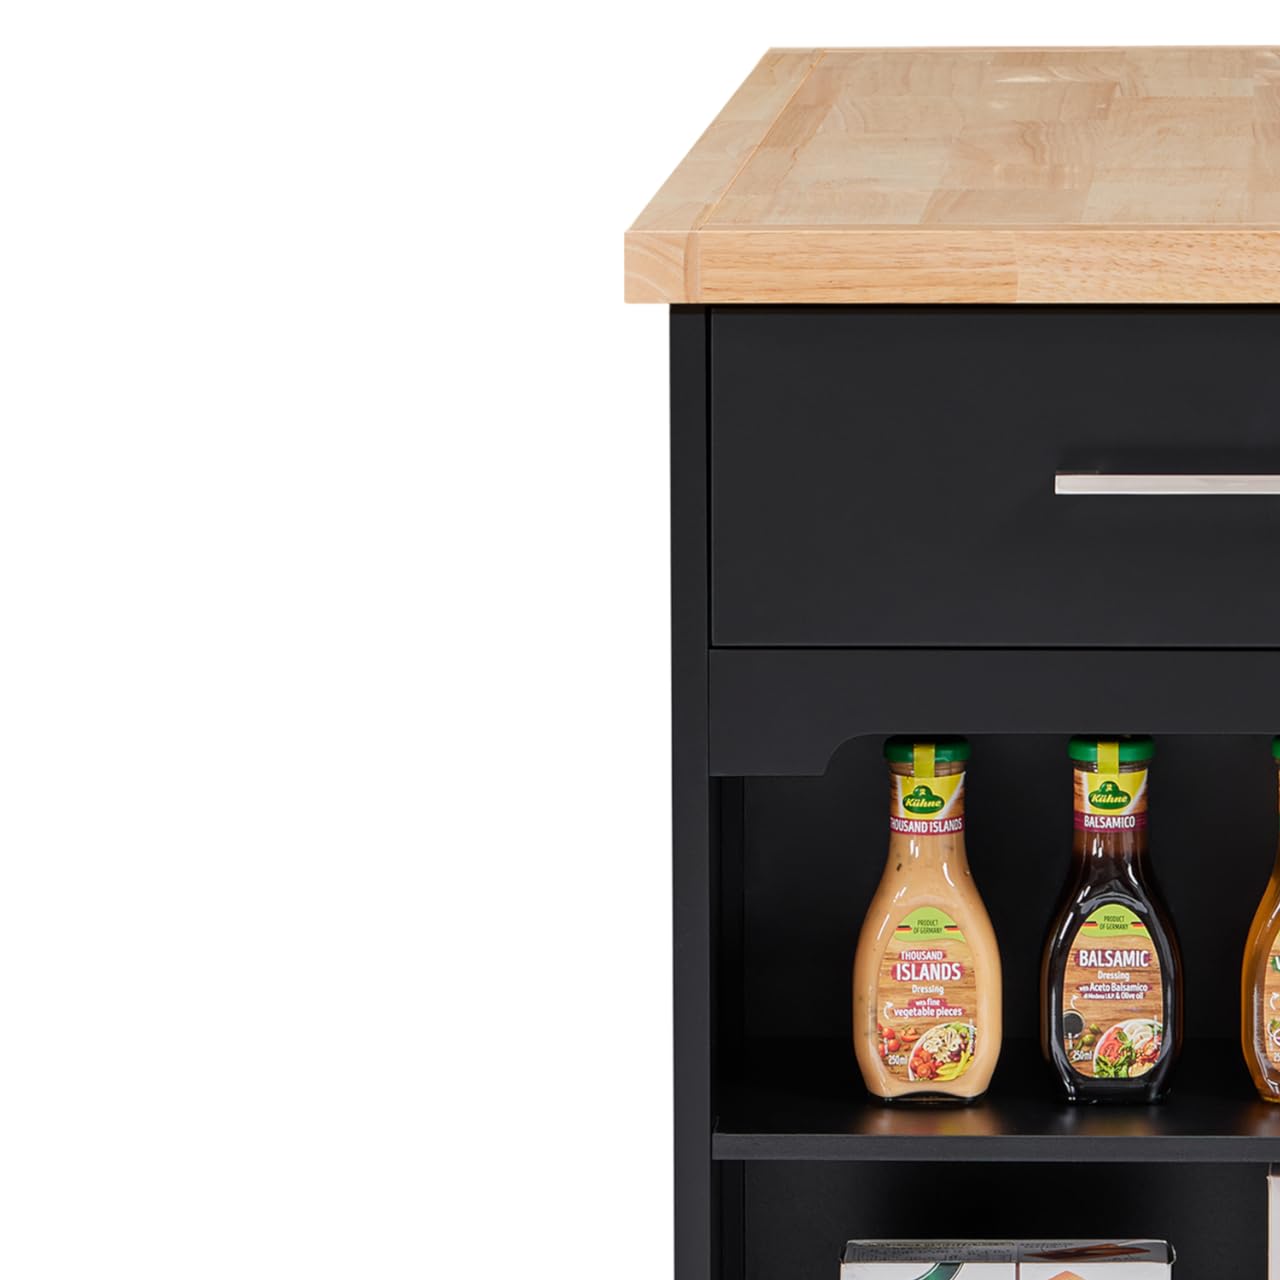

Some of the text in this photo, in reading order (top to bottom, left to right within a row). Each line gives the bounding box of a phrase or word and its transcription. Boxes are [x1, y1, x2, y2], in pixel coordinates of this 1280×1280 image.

[905, 798, 942, 808] Kühne
[1091, 794, 1128, 803] Kühne
[929, 818, 962, 833] ISLANDS
[1084, 815, 1136, 829] BALSAMICO
[900, 951, 943, 961] THOUSAND
[1079, 950, 1149, 967] BALSAMIC
[896, 963, 961, 981] ISLANDS
[1097, 971, 1130, 982] Dressing
[912, 984, 944, 995] Dressing
[1090, 982, 1110, 992] Aceto
[1111, 982, 1148, 992] Balsamico
[926, 998, 940, 1006] fine
[894, 1007, 963, 1018] vegetable pieces
